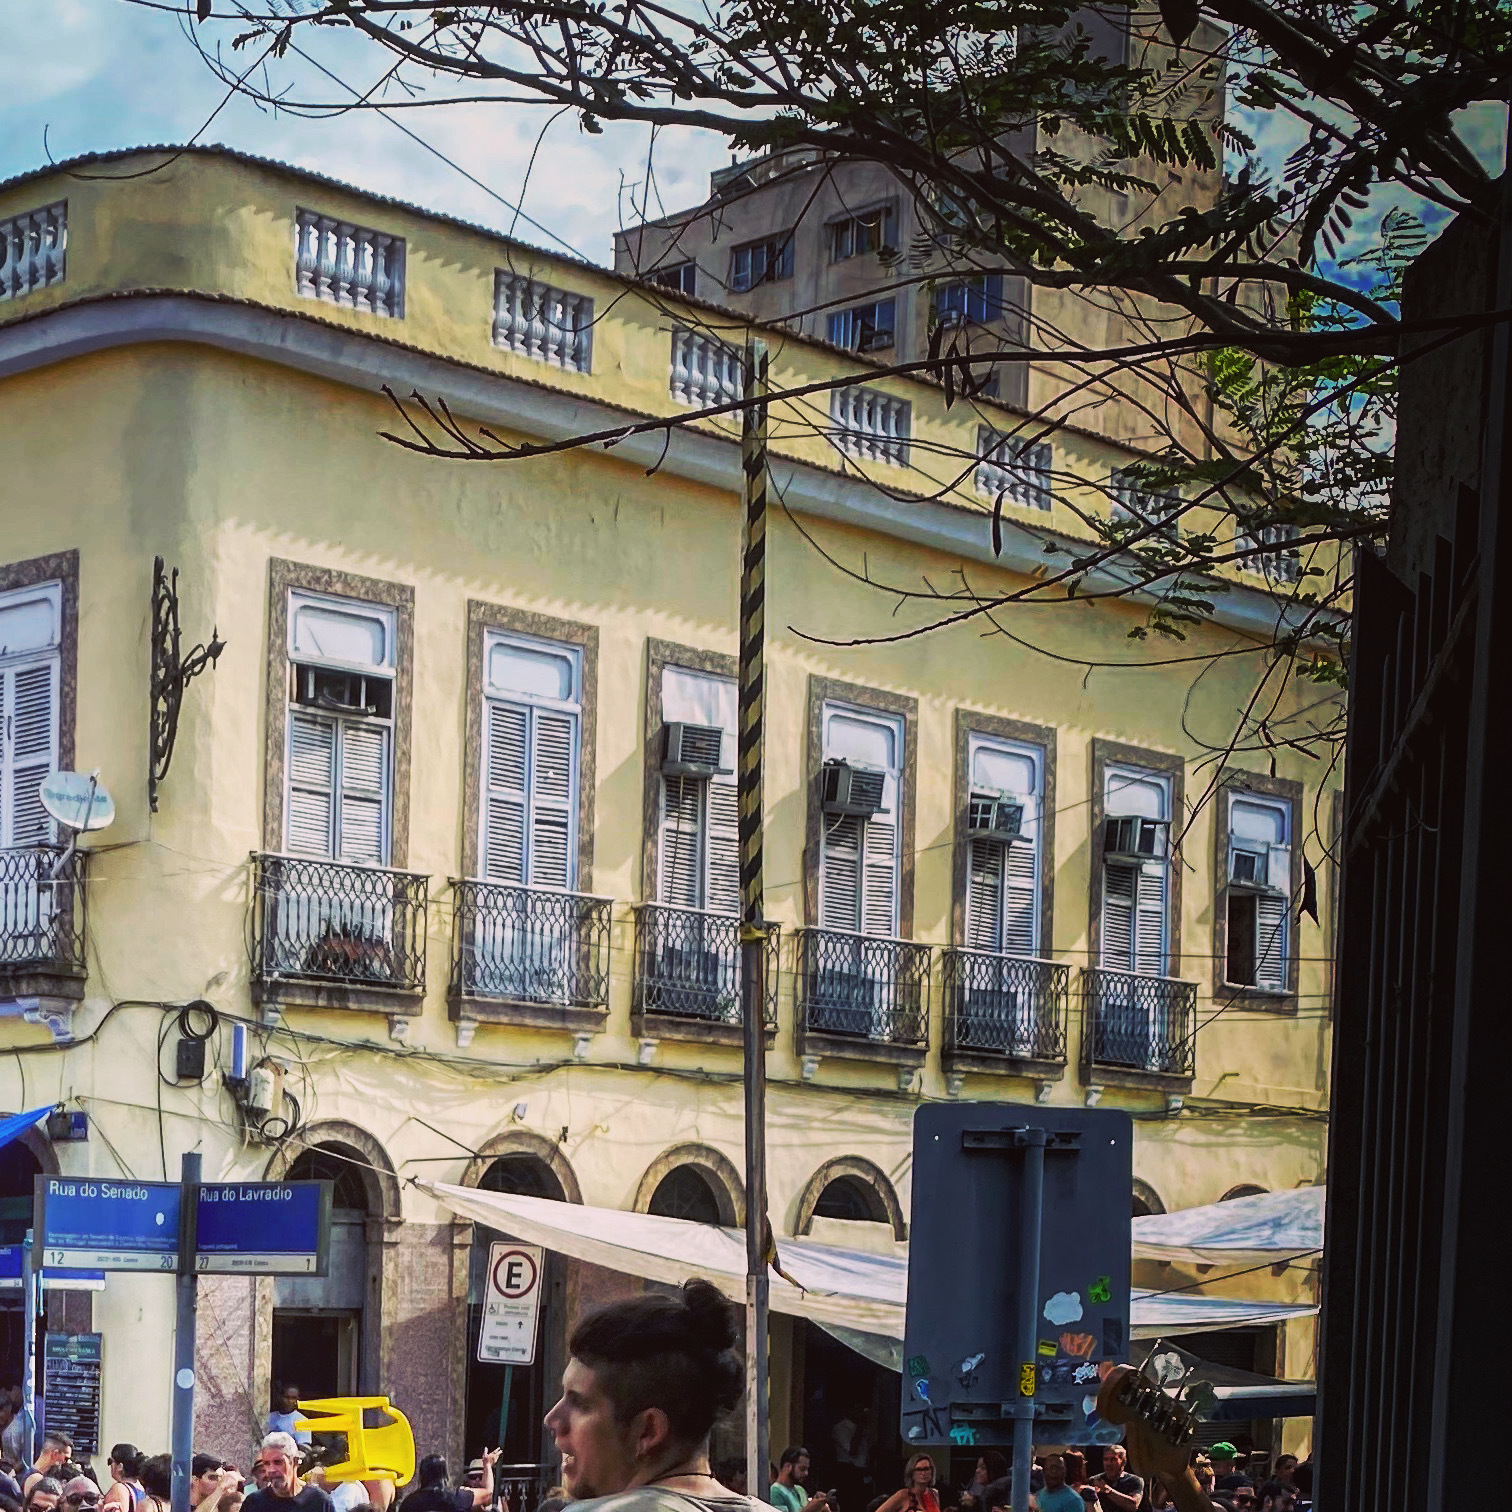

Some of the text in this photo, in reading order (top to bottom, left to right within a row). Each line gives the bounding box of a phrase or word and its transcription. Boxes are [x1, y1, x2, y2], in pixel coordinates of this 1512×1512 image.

[49, 1180, 148, 1200] Rua do Senado
[200, 1185, 293, 1202] Rua do Lavradio
[50, 1251, 64, 1265] 12
[160, 1255, 173, 1269] 20
[199, 1256, 209, 1270] 27
[506, 1261, 523, 1289] E
